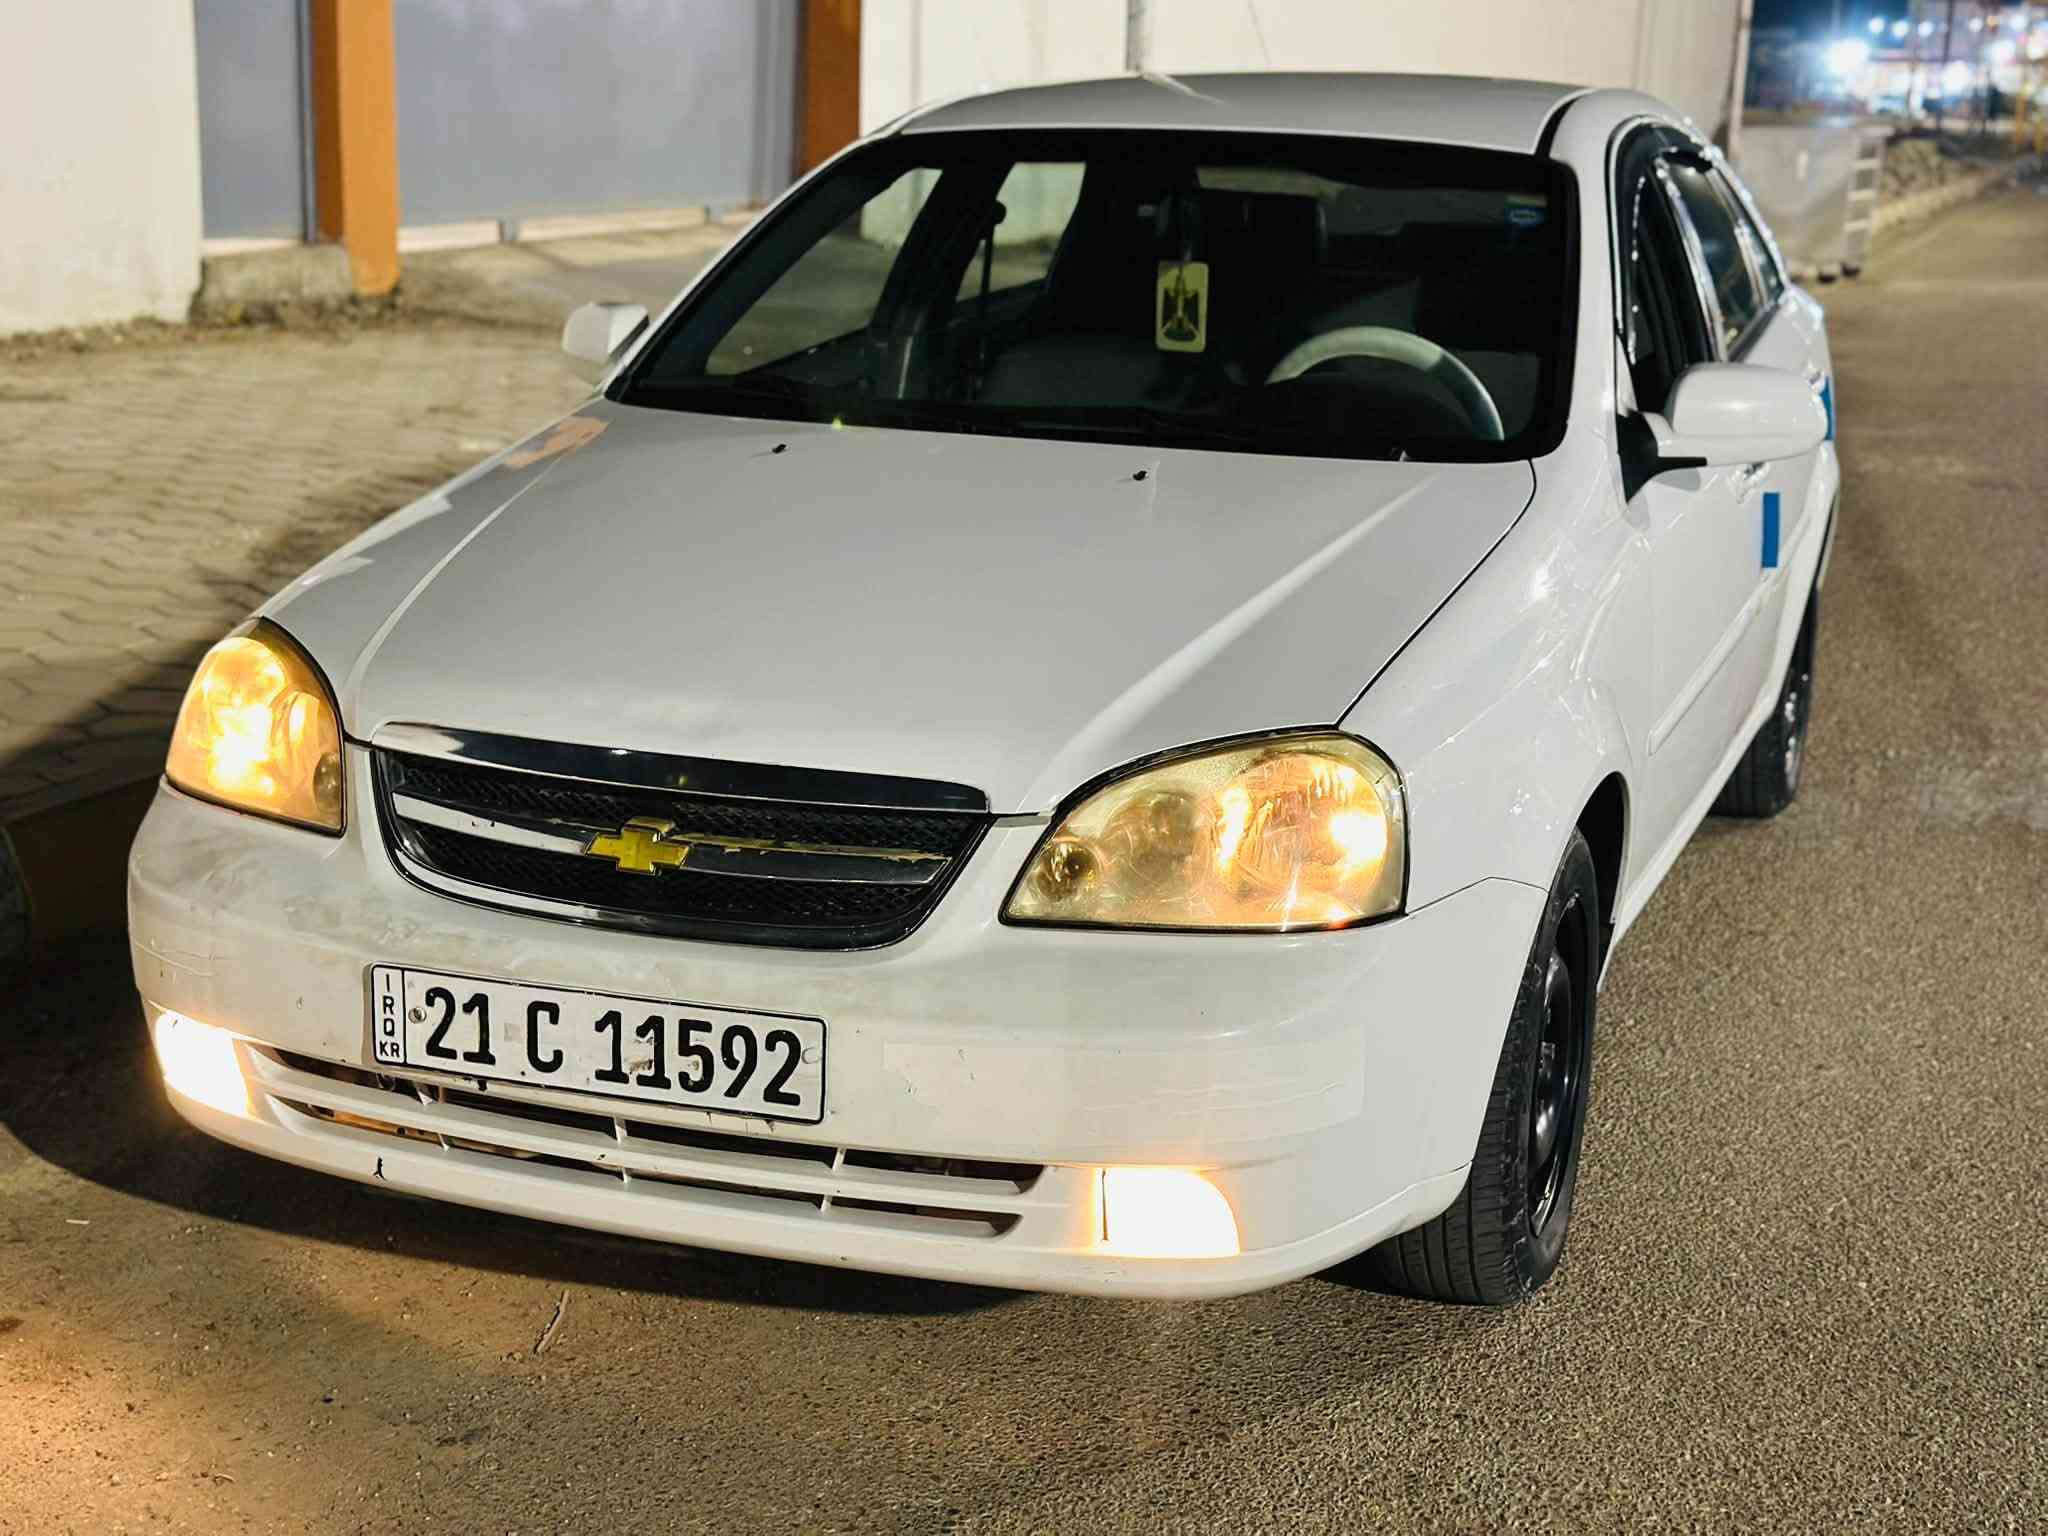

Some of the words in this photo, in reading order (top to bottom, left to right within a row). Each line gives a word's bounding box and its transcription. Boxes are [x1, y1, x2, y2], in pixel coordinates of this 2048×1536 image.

[379, 1041, 400, 1058] KR
[425, 986, 496, 1065] 21
[526, 1001, 563, 1073] C
[594, 1010, 801, 1106] 11592
